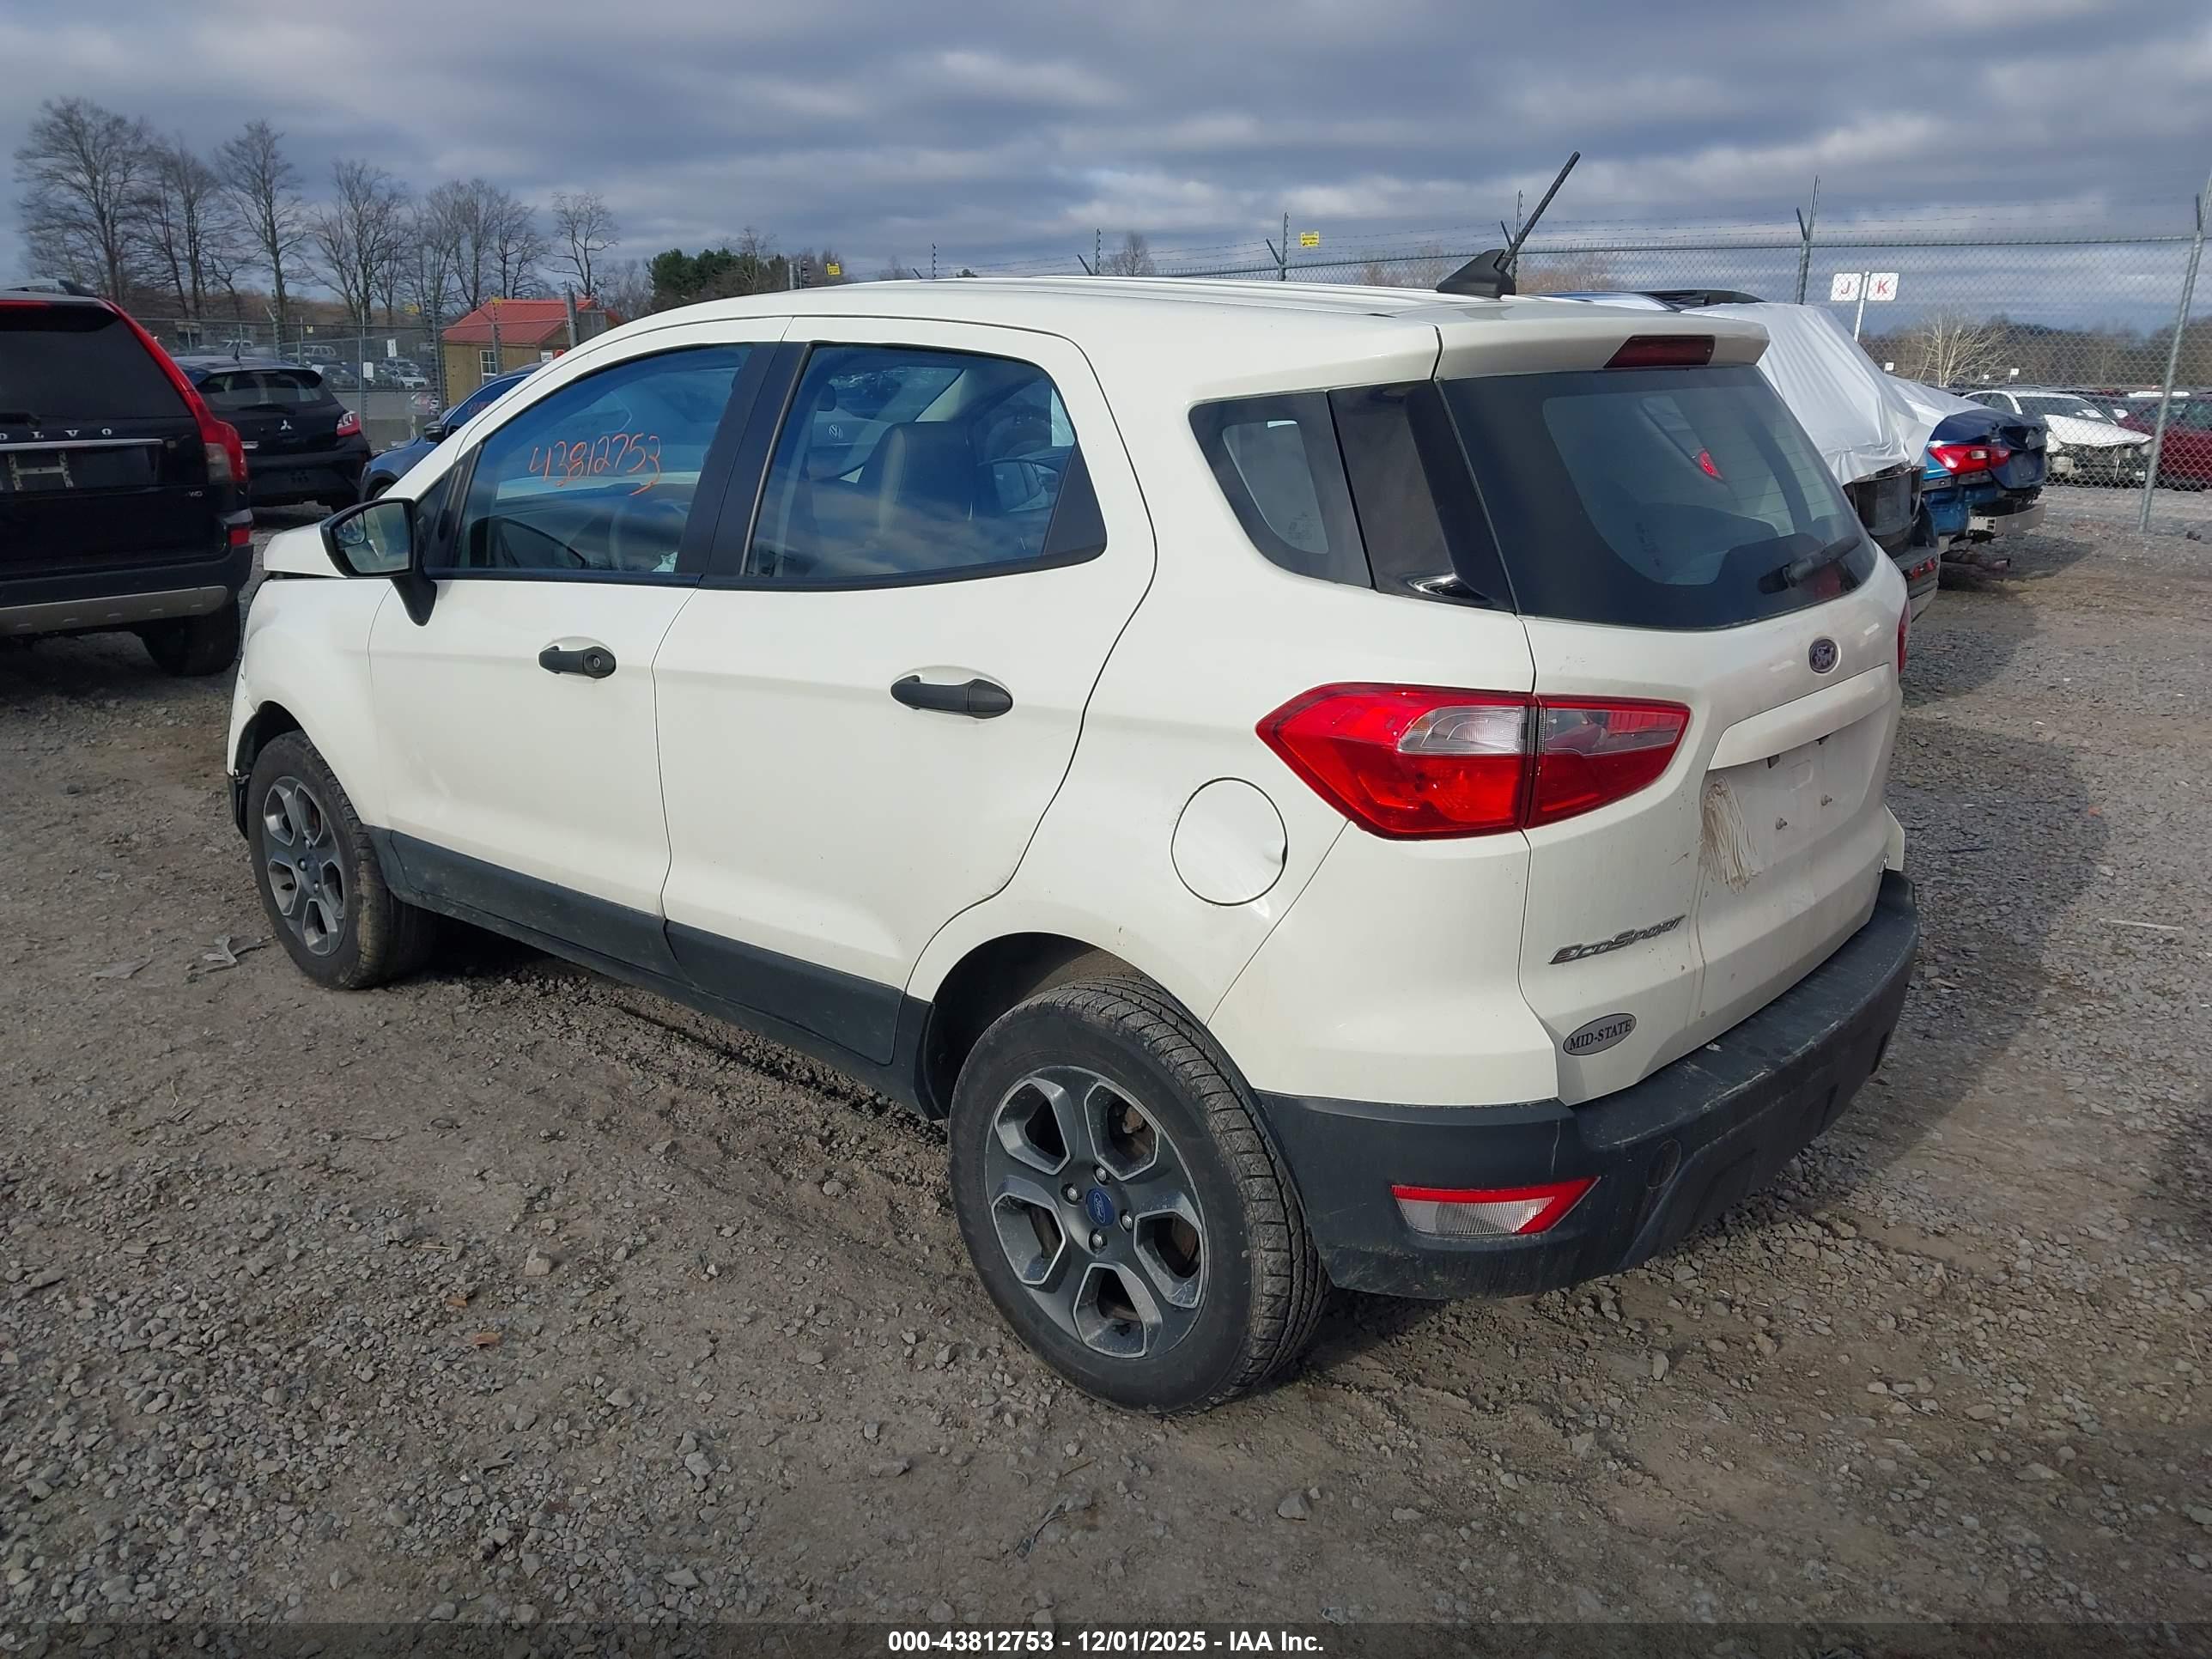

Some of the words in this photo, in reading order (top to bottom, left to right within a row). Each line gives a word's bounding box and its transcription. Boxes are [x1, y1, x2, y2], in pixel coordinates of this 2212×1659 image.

[1840, 281, 1851, 295] J
[1875, 280, 1889, 294] K
[529, 433, 661, 495] 43812753
[1569, 1018, 1633, 1051] MID-STATE
